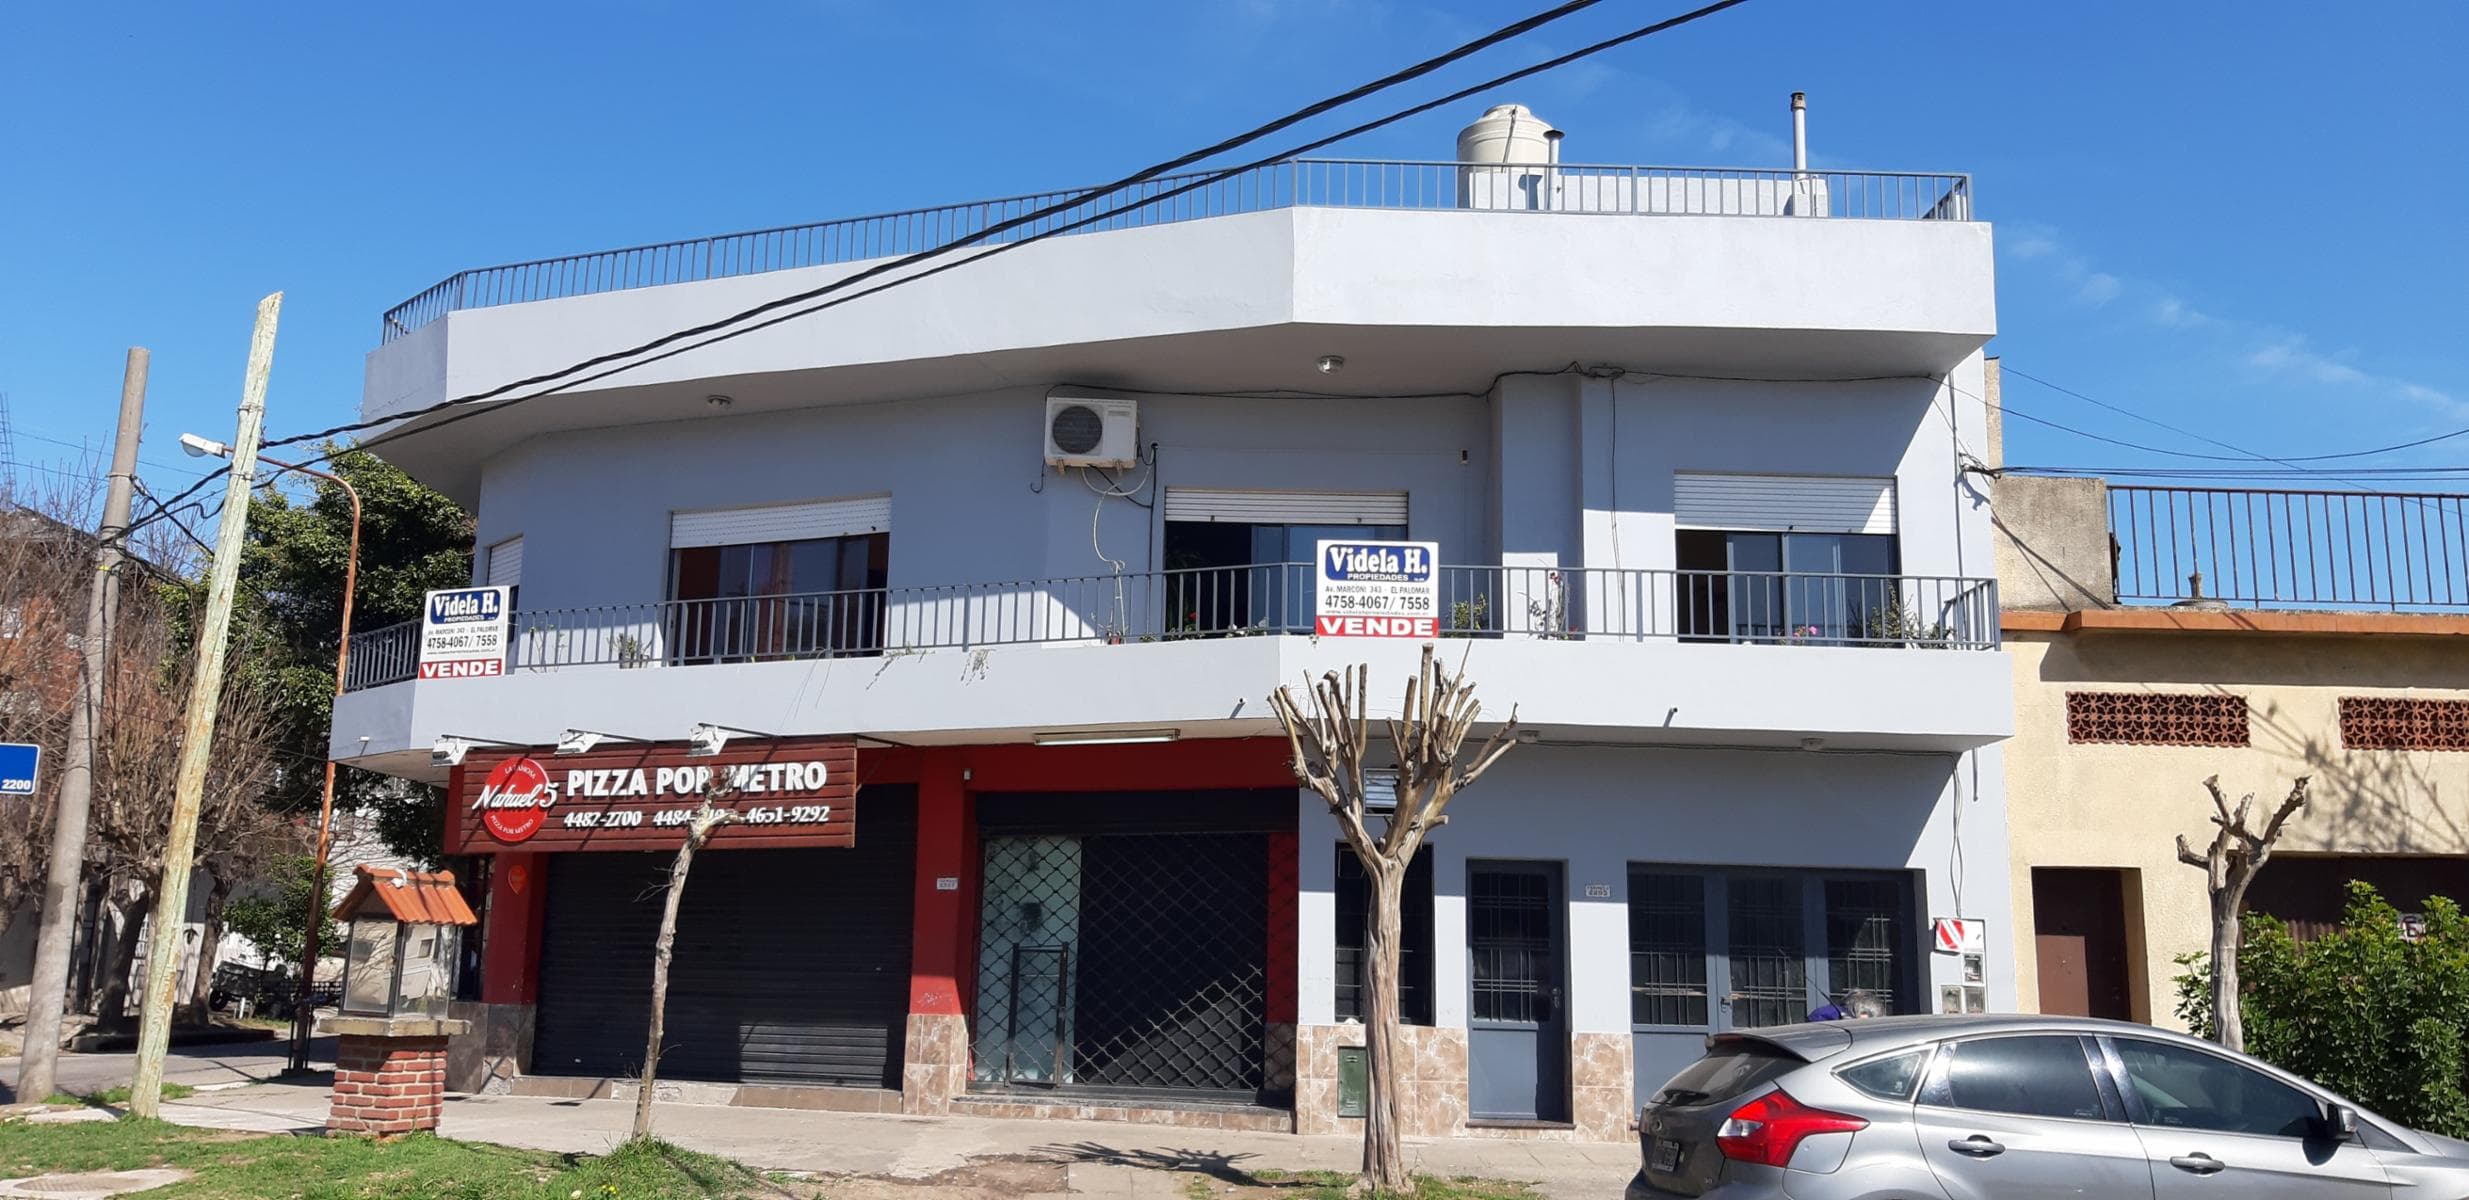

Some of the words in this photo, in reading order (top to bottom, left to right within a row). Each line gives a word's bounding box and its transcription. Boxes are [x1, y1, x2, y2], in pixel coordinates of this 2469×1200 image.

[1329, 547, 1399, 572] Videla
[1404, 549, 1427, 573] H.
[1347, 573, 1408, 581] PROPIEDADES
[434, 594, 478, 617] Videla
[481, 592, 498, 614] H.
[1400, 597, 1430, 610] 7558
[1320, 617, 1433, 636] VENDE
[476, 634, 498, 647] 7558
[422, 661, 499, 677] VENDE
[1, 779, 31, 790] 2200
[567, 768, 649, 796] PIZZA
[729, 762, 827, 793] METRO
[472, 784, 543, 809] Nahuel
[539, 782, 560, 808] 5
[564, 811, 643, 827] 4482-2700
